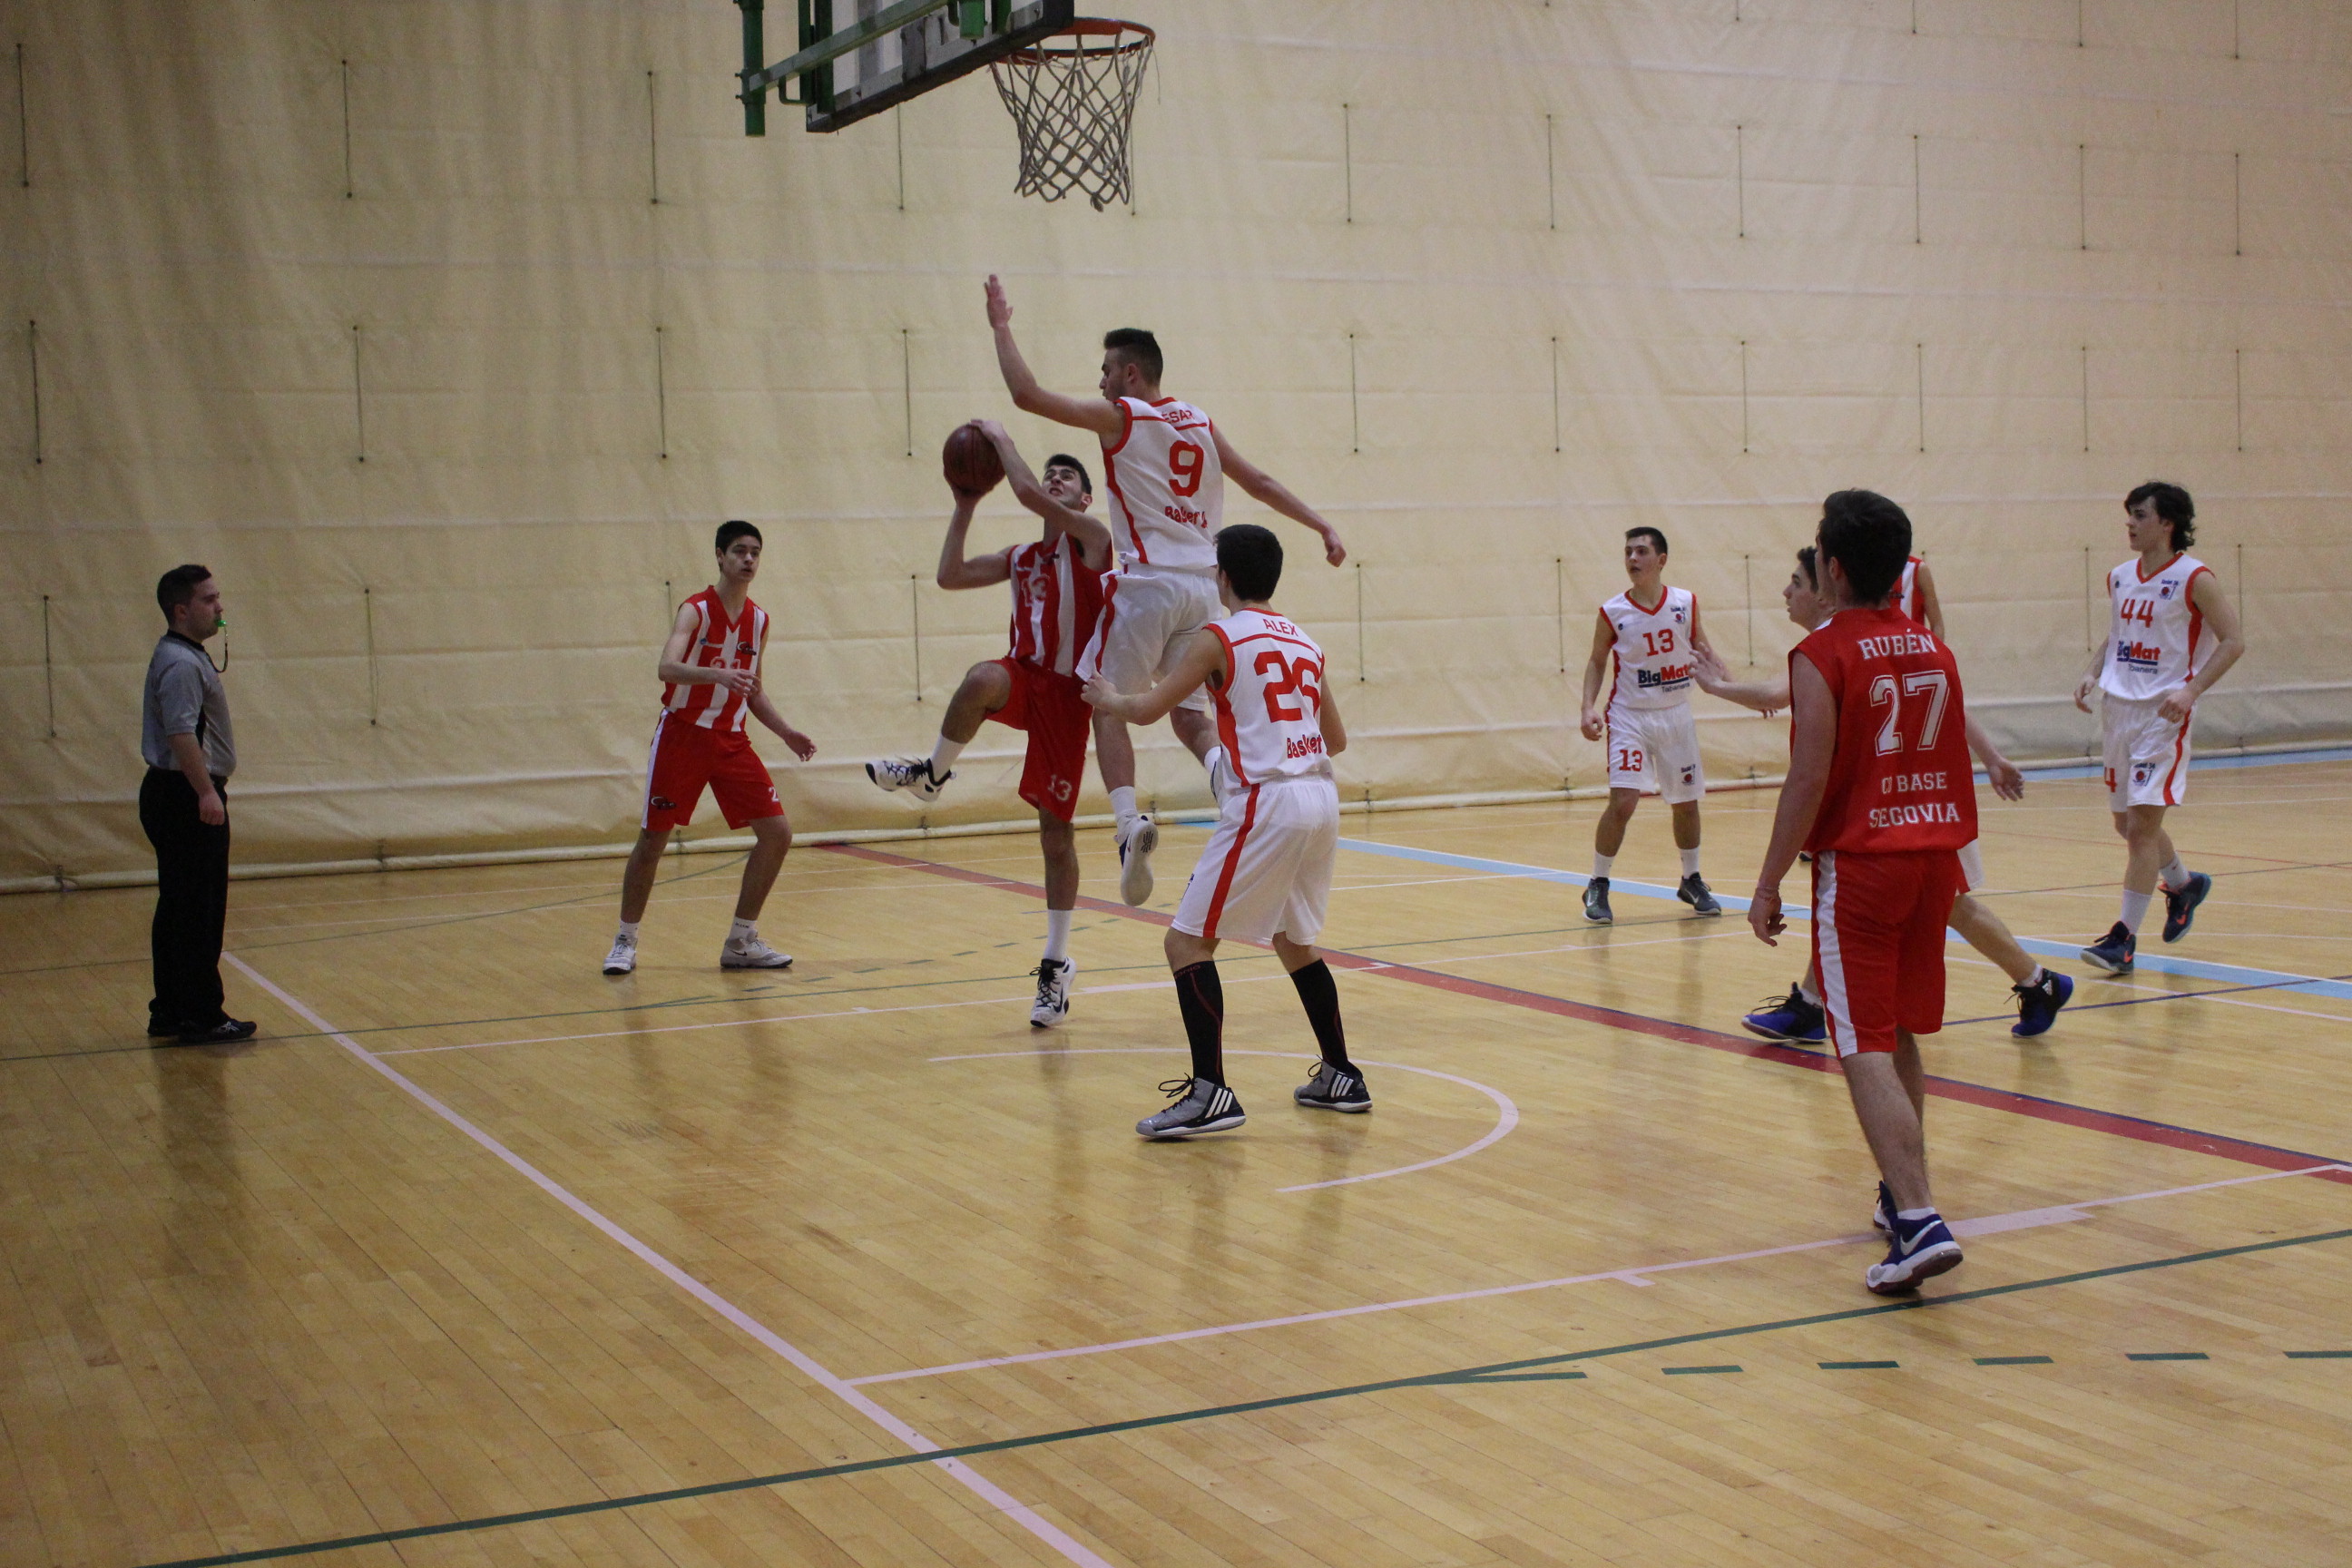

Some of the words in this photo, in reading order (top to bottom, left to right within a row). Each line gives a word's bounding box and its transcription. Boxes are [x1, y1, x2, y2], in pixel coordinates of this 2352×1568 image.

[1161, 408, 1195, 424] ESAR
[1168, 440, 1205, 498] 9
[1262, 618, 1299, 637] ALEX
[2120, 599, 2155, 628] 44
[1642, 628, 1674, 657] 13
[1857, 627, 1937, 661] RUBÉN
[1253, 650, 1321, 723] 26
[1868, 670, 1951, 757] 27
[1286, 734, 1323, 759] Basket
[1618, 749, 1643, 772] 13
[1047, 773, 1073, 802] 13
[1896, 771, 1948, 793] BASE
[1868, 802, 1961, 828] SEGOVIA
